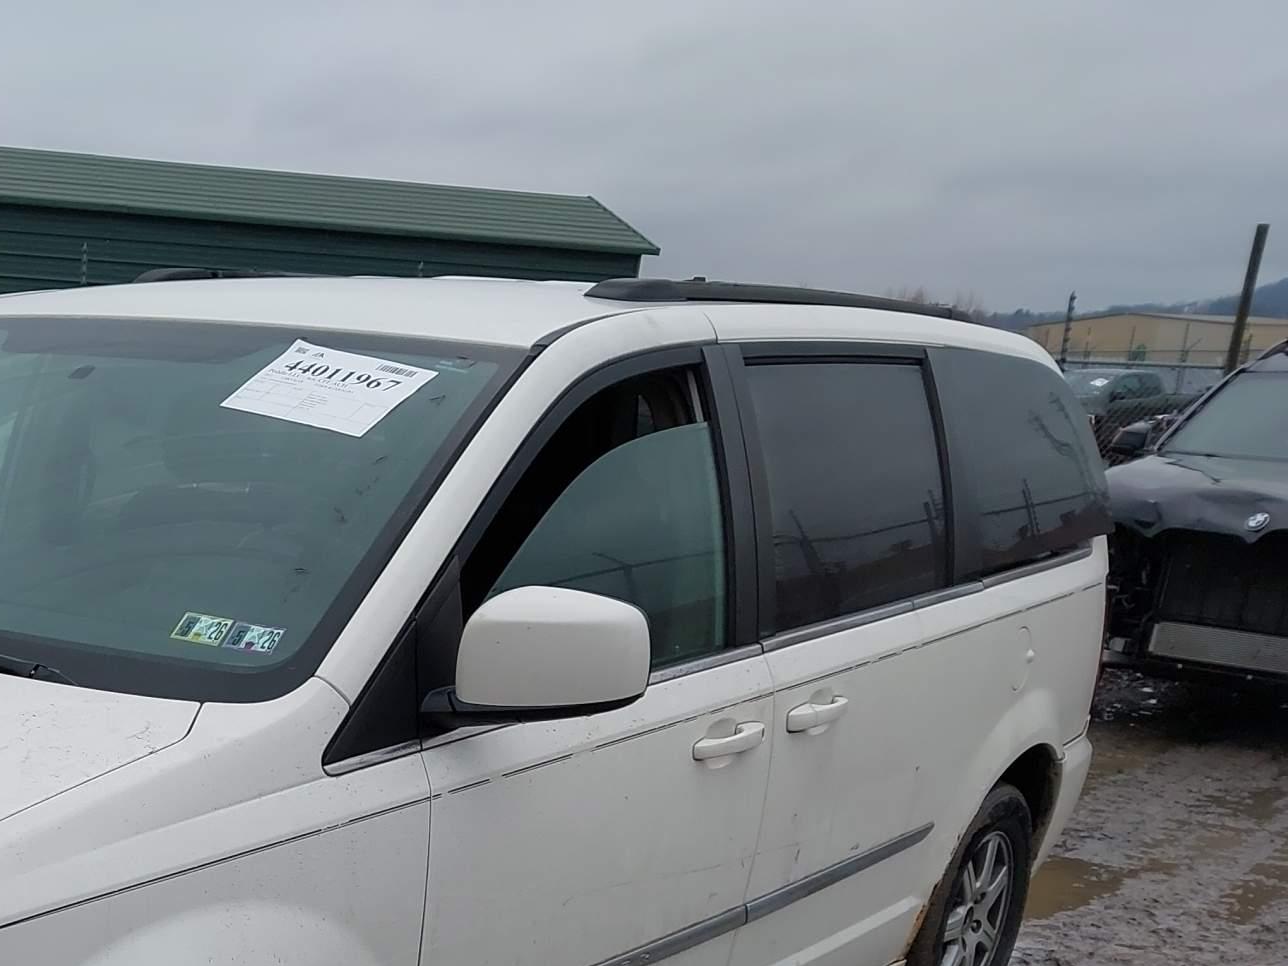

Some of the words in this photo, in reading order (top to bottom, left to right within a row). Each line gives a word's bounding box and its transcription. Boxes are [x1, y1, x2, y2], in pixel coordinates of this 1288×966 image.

[285, 360, 402, 392] 44011967
[207, 621, 228, 641] 26
[260, 630, 281, 650] 26
